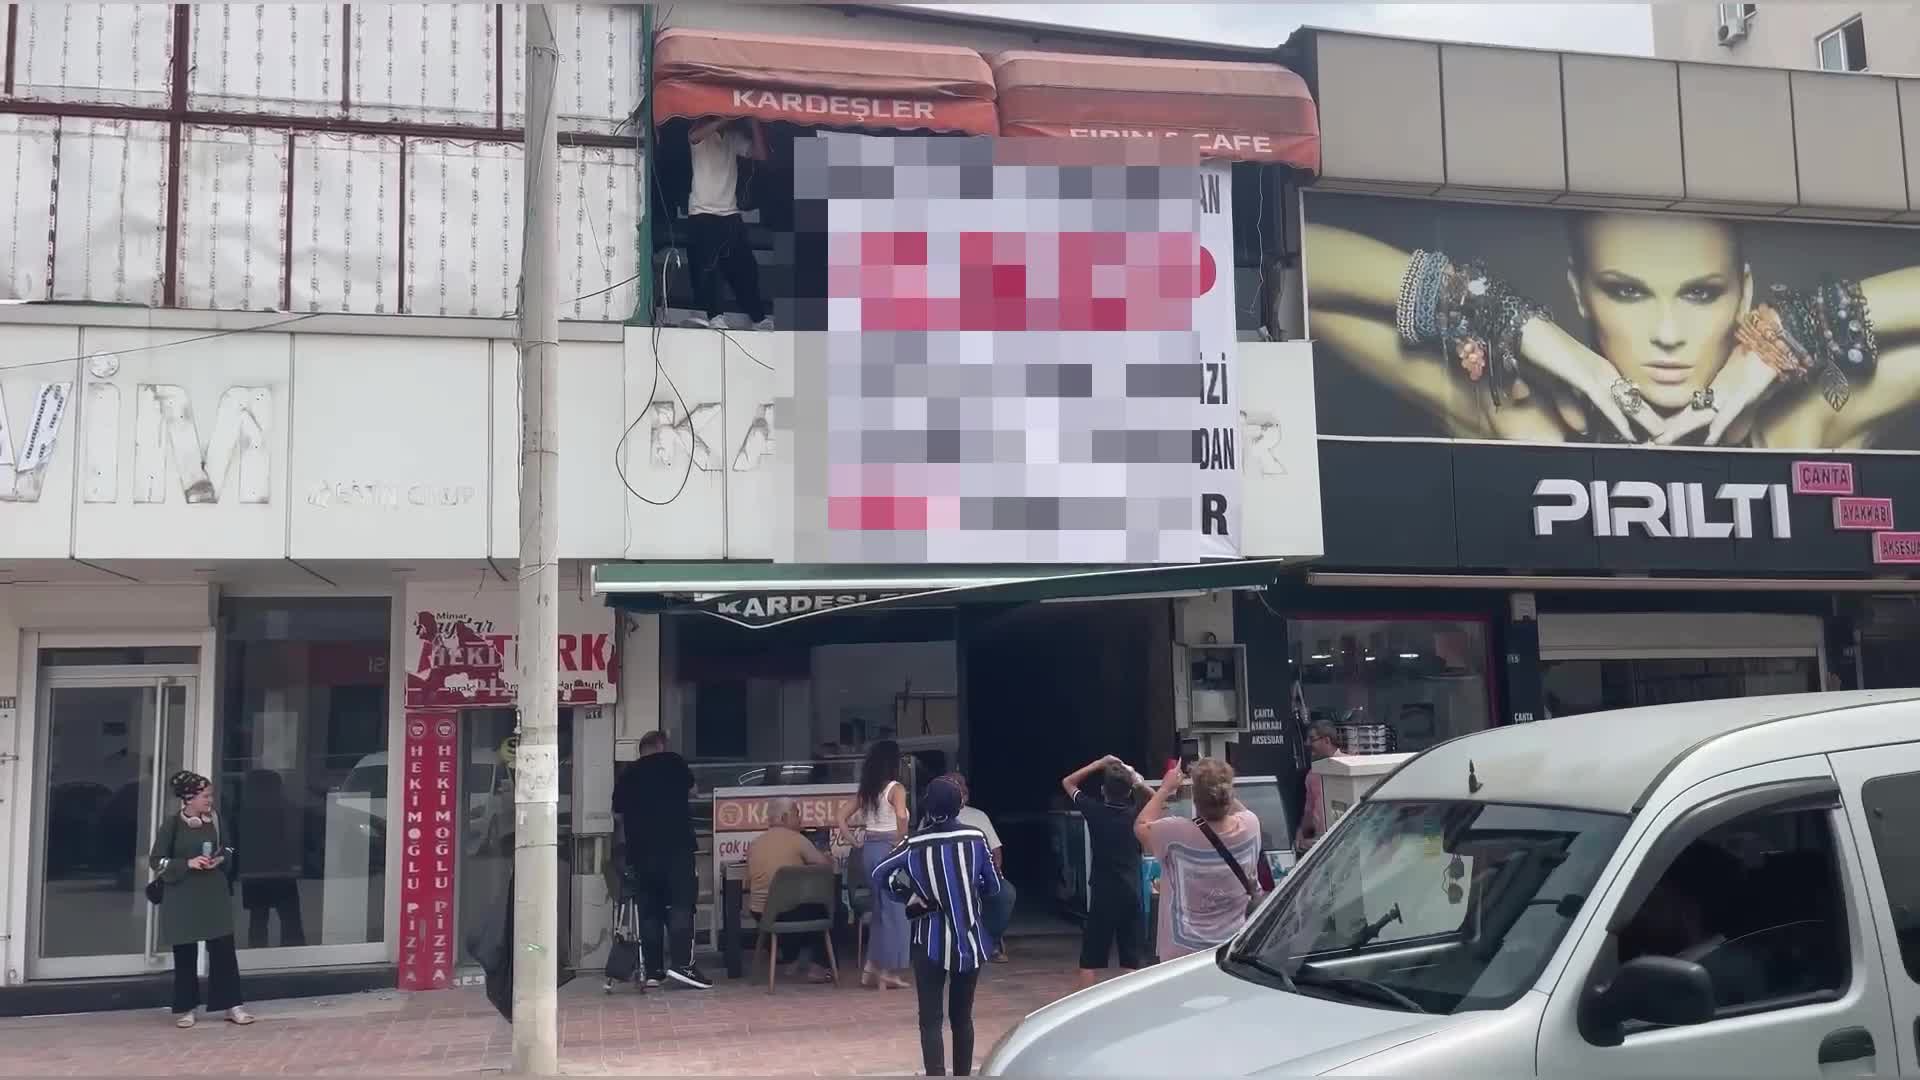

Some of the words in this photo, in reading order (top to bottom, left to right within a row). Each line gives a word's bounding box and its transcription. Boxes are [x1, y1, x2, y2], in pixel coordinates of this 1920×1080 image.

[732, 88, 936, 122] KARDEŞLER
[1802, 467, 1850, 488] ÇANTA
[1532, 478, 1792, 539] PIRILTI
[1843, 504, 1890, 521] AYAKKABI
[1251, 735, 1284, 745] AKSESUAR
[434, 745, 452, 889] HEKİMOĞLU
[432, 901, 448, 981] PİZZA
